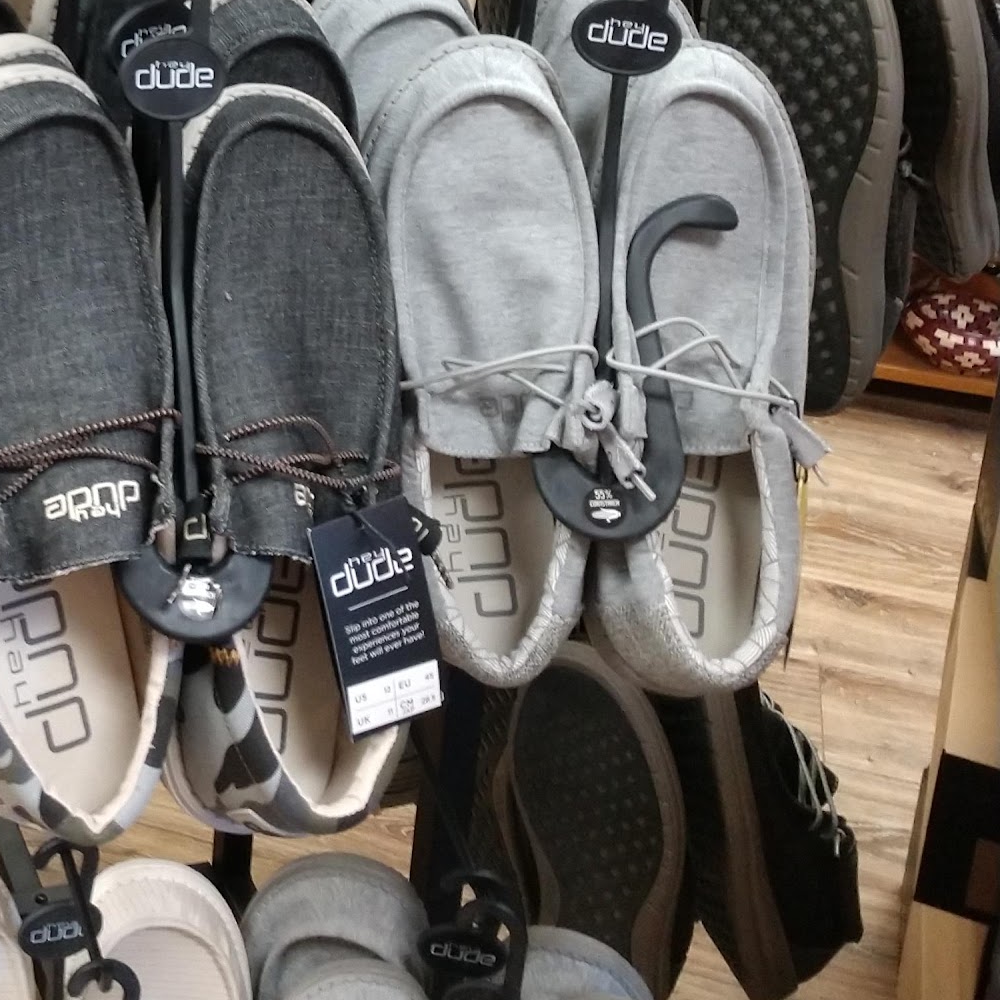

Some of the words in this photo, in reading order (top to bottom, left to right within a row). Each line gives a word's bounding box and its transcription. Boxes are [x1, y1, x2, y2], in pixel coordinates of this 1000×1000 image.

[587, 19, 668, 52] dude
[610, 17, 645, 33] hey
[135, 61, 214, 90] dude
[42, 480, 140, 522] dude
[330, 547, 414, 598] dude
[348, 547, 386, 568] hey
[344, 623, 361, 635] Slip
[361, 616, 379, 628] into
[378, 610, 395, 622] one
[394, 604, 405, 615] of
[404, 600, 420, 612] the
[349, 630, 370, 645] most
[371, 611, 420, 635] comfortable
[351, 652, 369, 666] feet
[369, 645, 384, 658] will
[383, 640, 402, 653] ever
[352, 630, 401, 654] experiences
[401, 621, 420, 637] your
[0, 612, 31, 708] hey
[1, 579, 92, 753] dud
[354, 693, 368, 703] US
[398, 679, 411, 690] EU
[357, 716, 371, 726] UK
[30, 921, 84, 945] dud
[431, 943, 496, 967] dude
